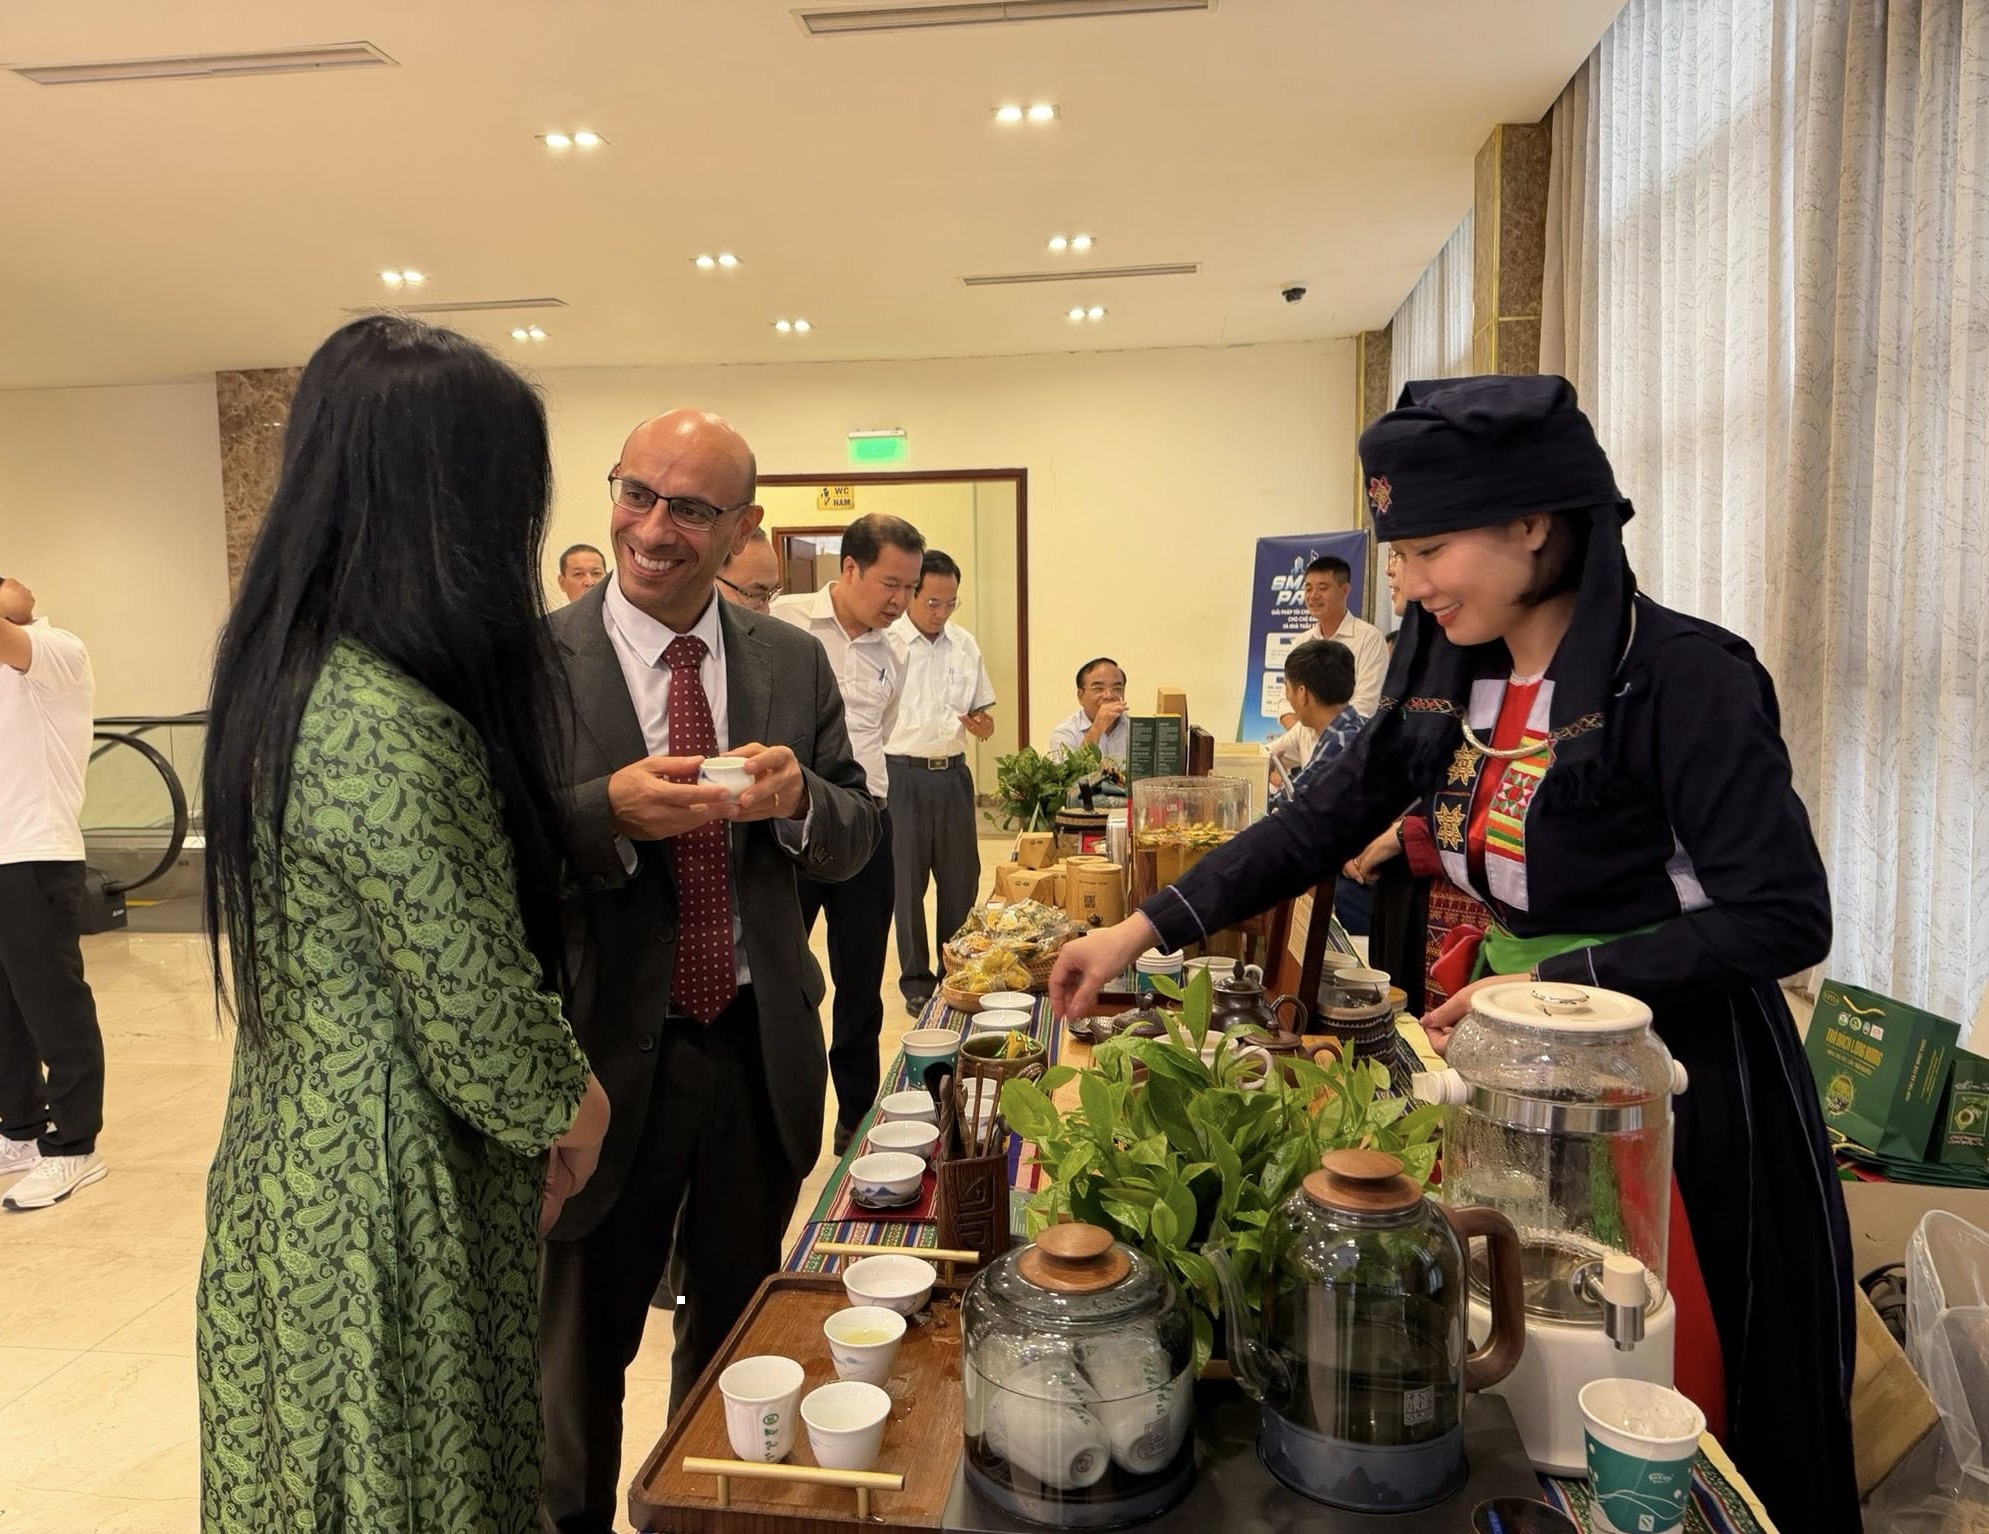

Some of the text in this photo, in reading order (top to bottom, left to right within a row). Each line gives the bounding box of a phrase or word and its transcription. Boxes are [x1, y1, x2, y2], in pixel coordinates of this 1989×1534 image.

[834, 487, 849, 495] WC
[834, 498, 850, 506] NAM
[1271, 575, 1306, 590] SM
[1276, 590, 1305, 605] PA
